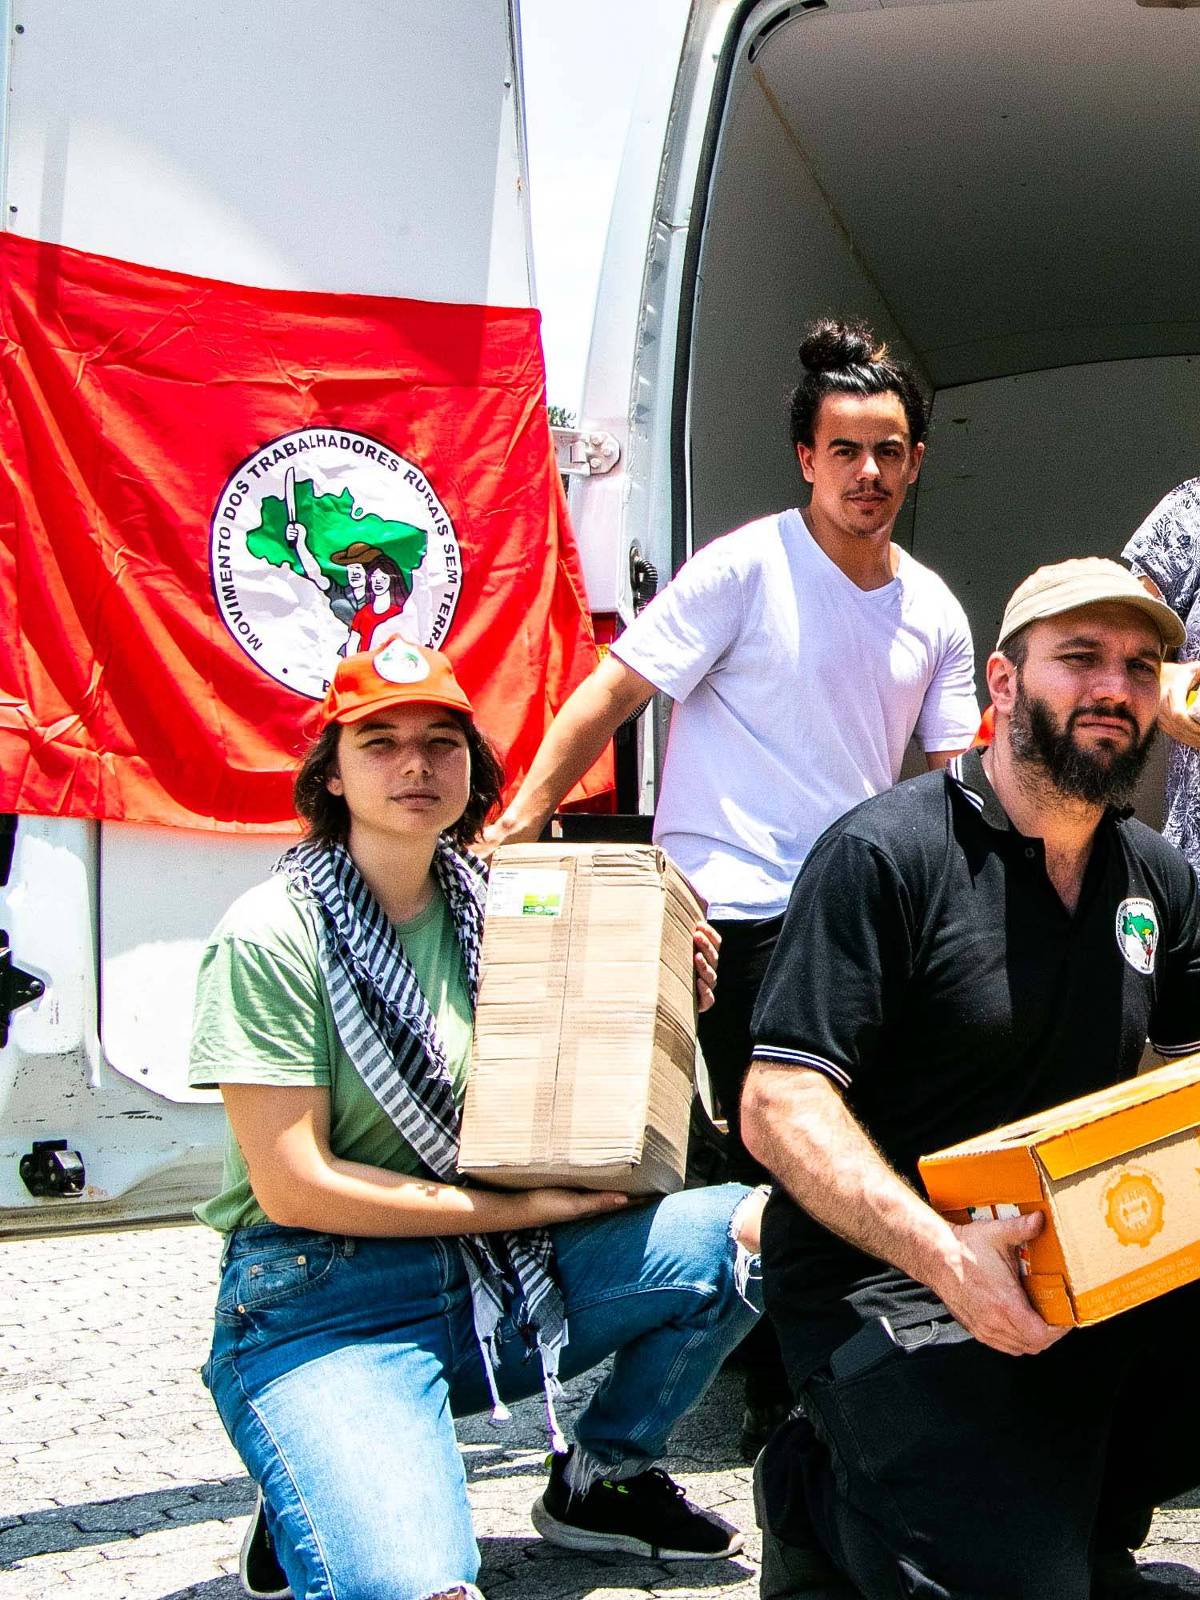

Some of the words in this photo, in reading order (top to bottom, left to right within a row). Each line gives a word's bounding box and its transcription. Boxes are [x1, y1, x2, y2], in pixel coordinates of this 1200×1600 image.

[246, 434, 400, 480] TRABALHADORES
[223, 480, 250, 521] DOS
[403, 470, 449, 537] RURAIS
[217, 526, 263, 651] MOVIMENTO
[443, 544, 458, 585] SEM
[424, 591, 455, 649] TERRA
